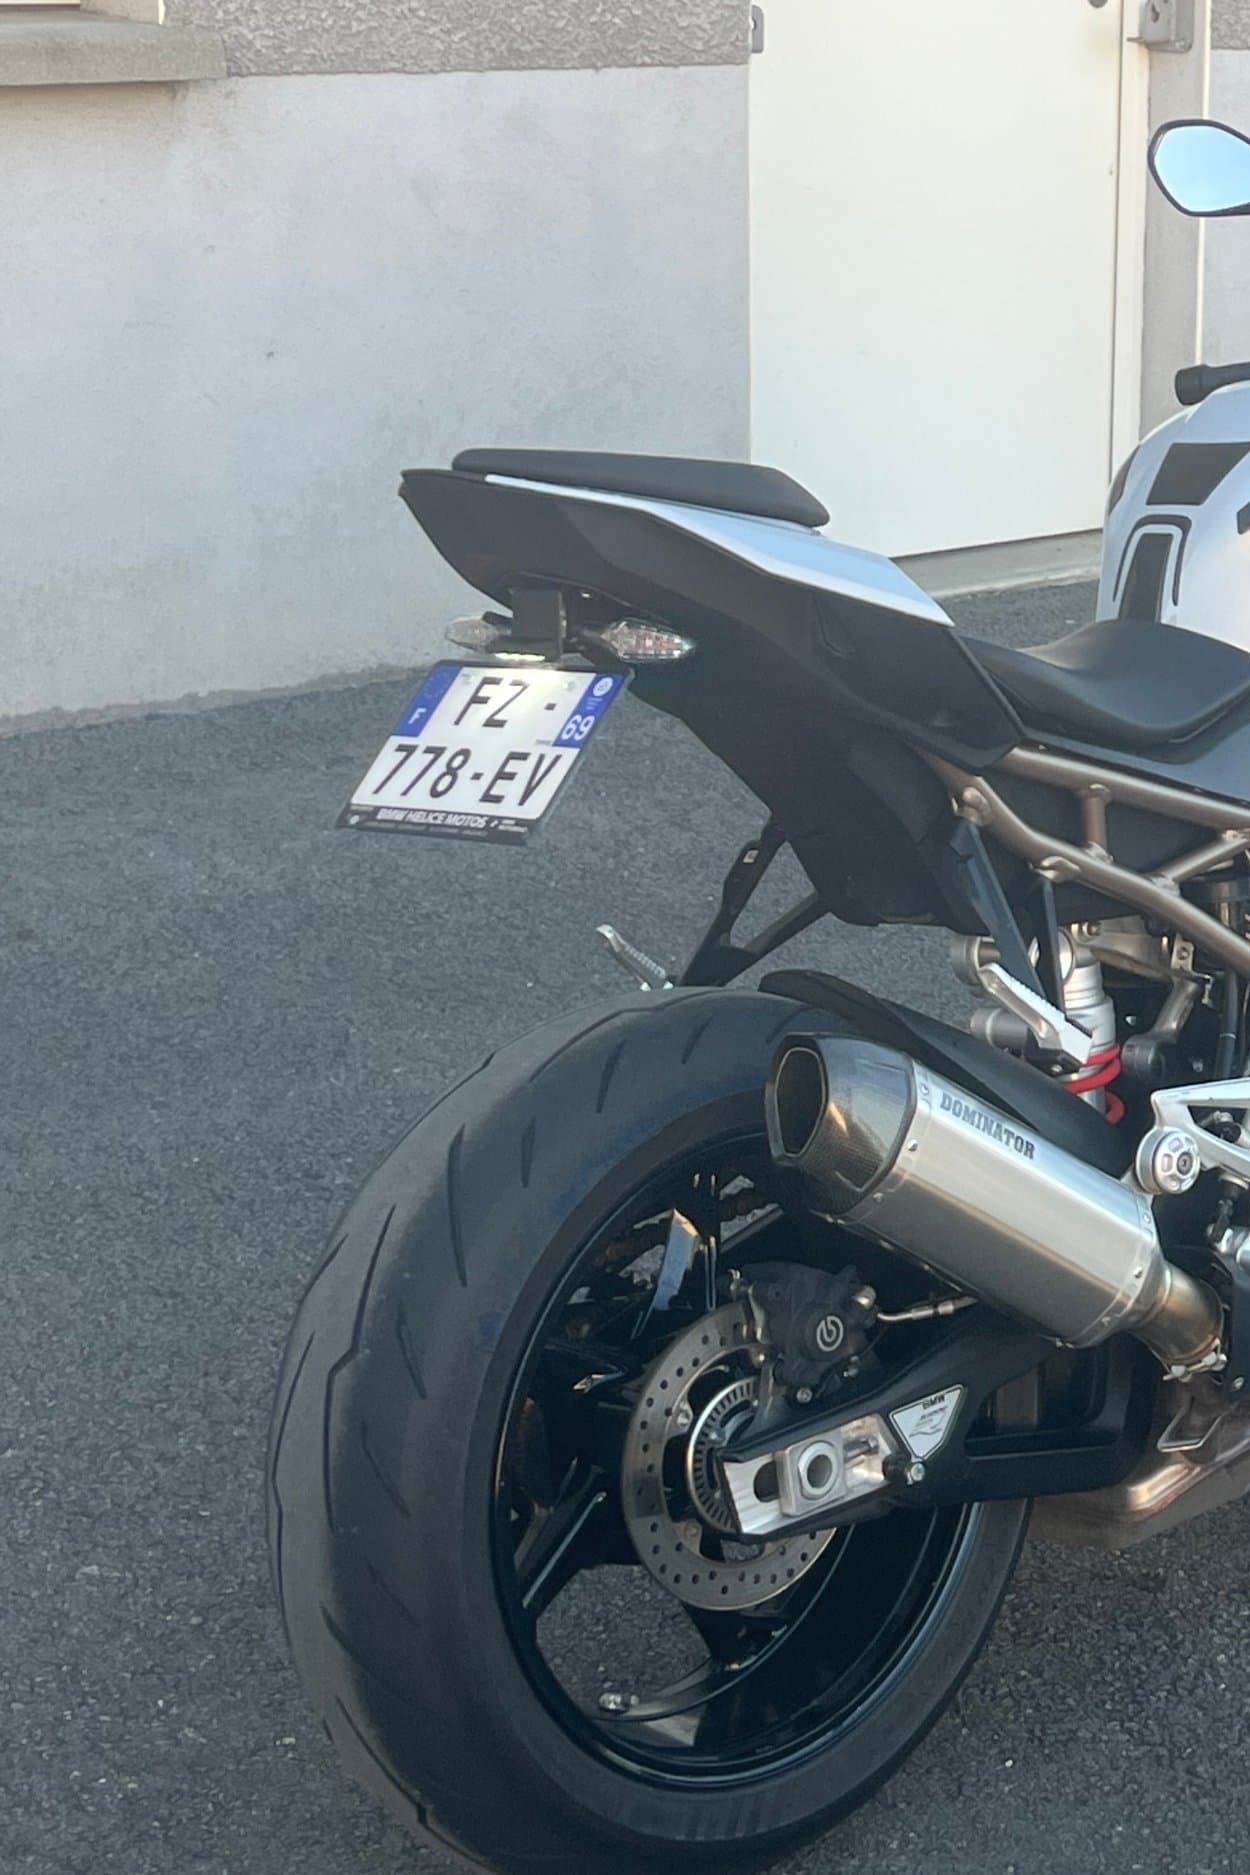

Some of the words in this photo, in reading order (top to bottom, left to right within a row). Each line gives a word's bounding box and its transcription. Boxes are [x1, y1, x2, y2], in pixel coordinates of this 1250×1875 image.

[408, 708, 426, 724] F
[561, 714, 595, 740] 69
[372, 744, 562, 806] 778-EV
[444, 814, 488, 828] MOTOS
[940, 1092, 1035, 1160] DOMINATOR
